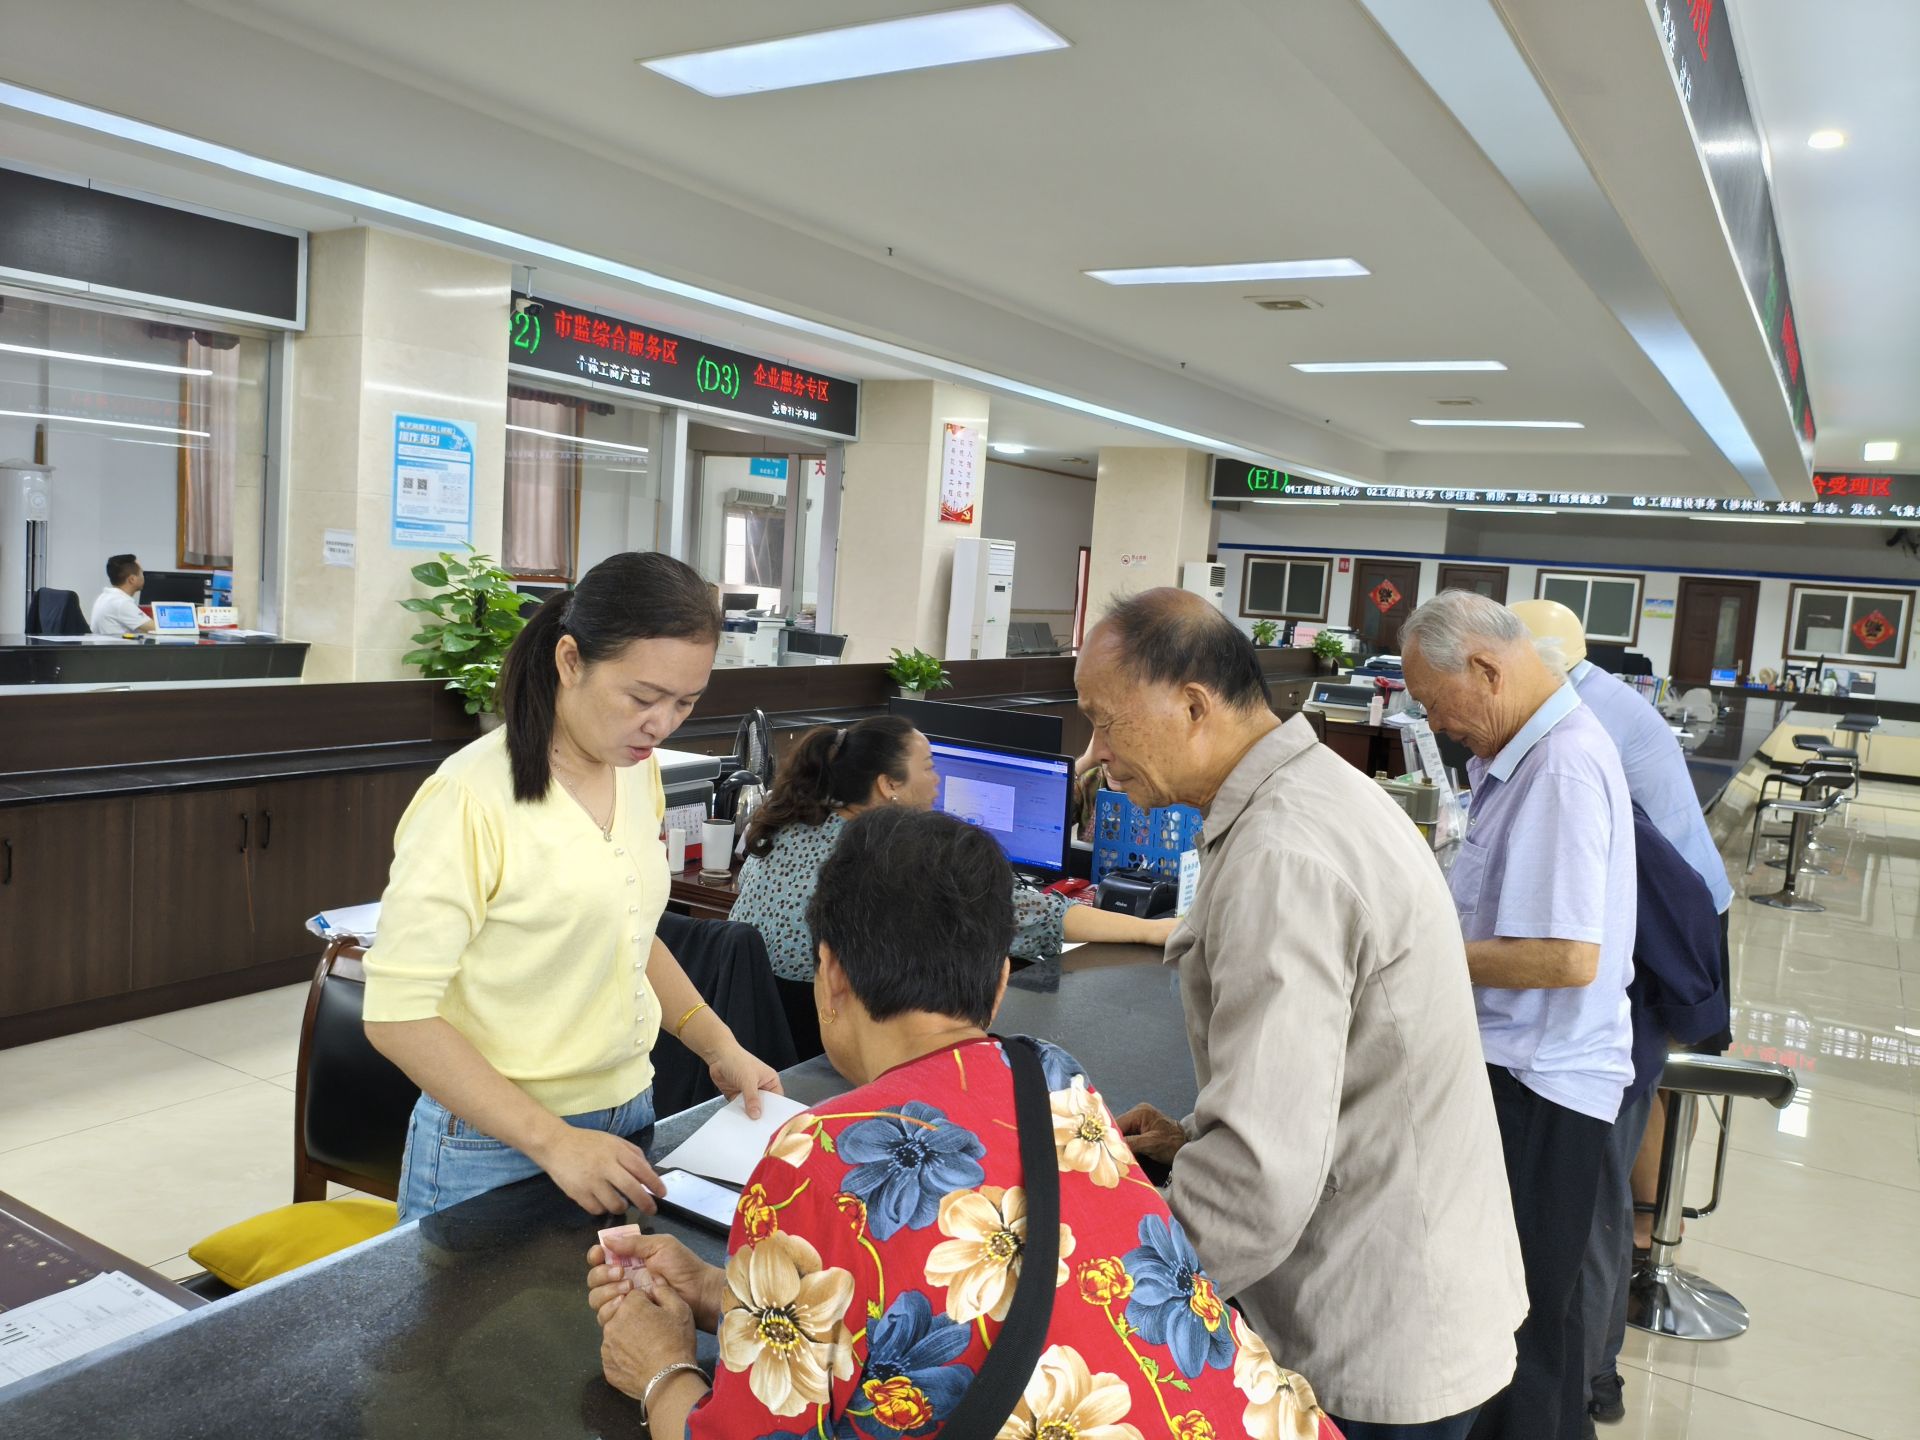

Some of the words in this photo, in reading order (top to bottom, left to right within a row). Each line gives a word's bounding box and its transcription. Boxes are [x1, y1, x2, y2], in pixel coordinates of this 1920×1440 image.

[554, 310, 679, 365] 市监综合服务区
[697, 355, 740, 399] (D3)
[753, 362, 829, 402] 企业服务专区
[1247, 467, 1289, 491] (E1)
